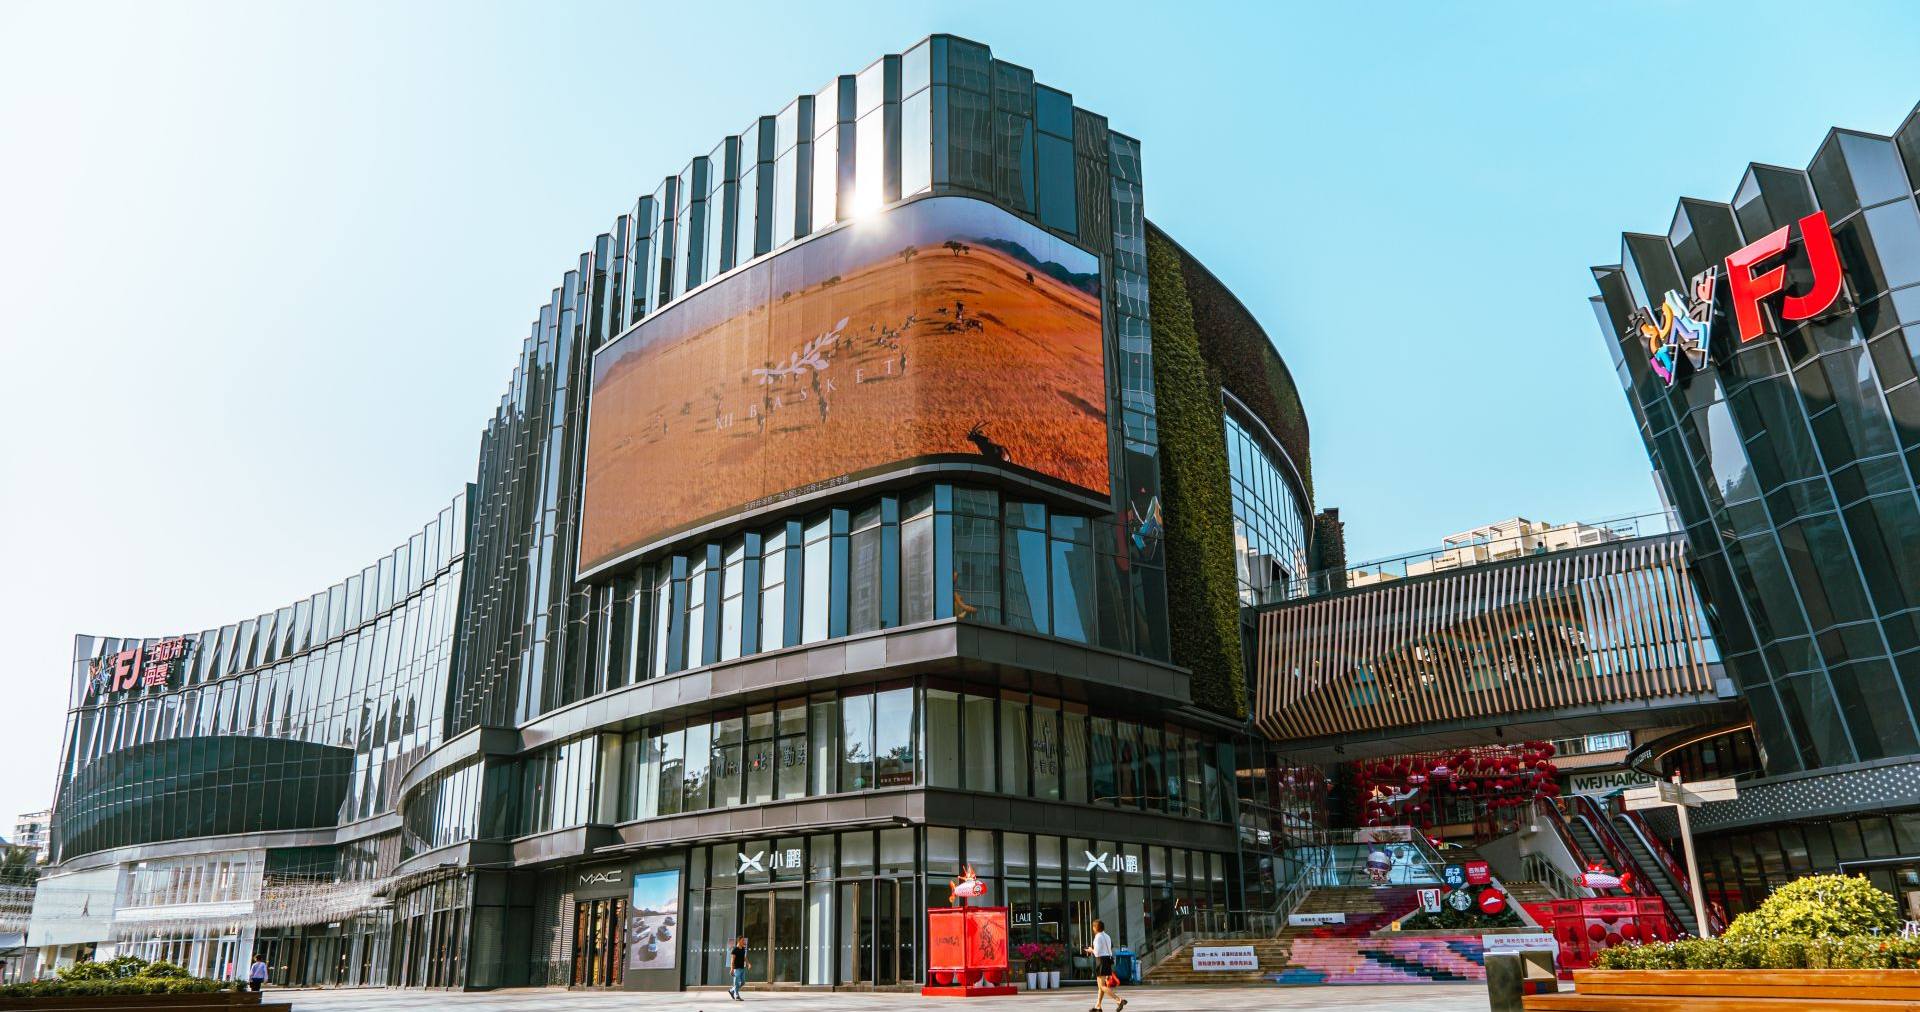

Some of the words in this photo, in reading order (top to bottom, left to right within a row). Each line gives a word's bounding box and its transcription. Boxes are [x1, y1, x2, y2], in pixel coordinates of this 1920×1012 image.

[750, 359, 895, 418] BASKET
[1574, 775, 1604, 790] WFJ
[769, 848, 801, 870] 小鹏
[579, 869, 623, 887] MAC
